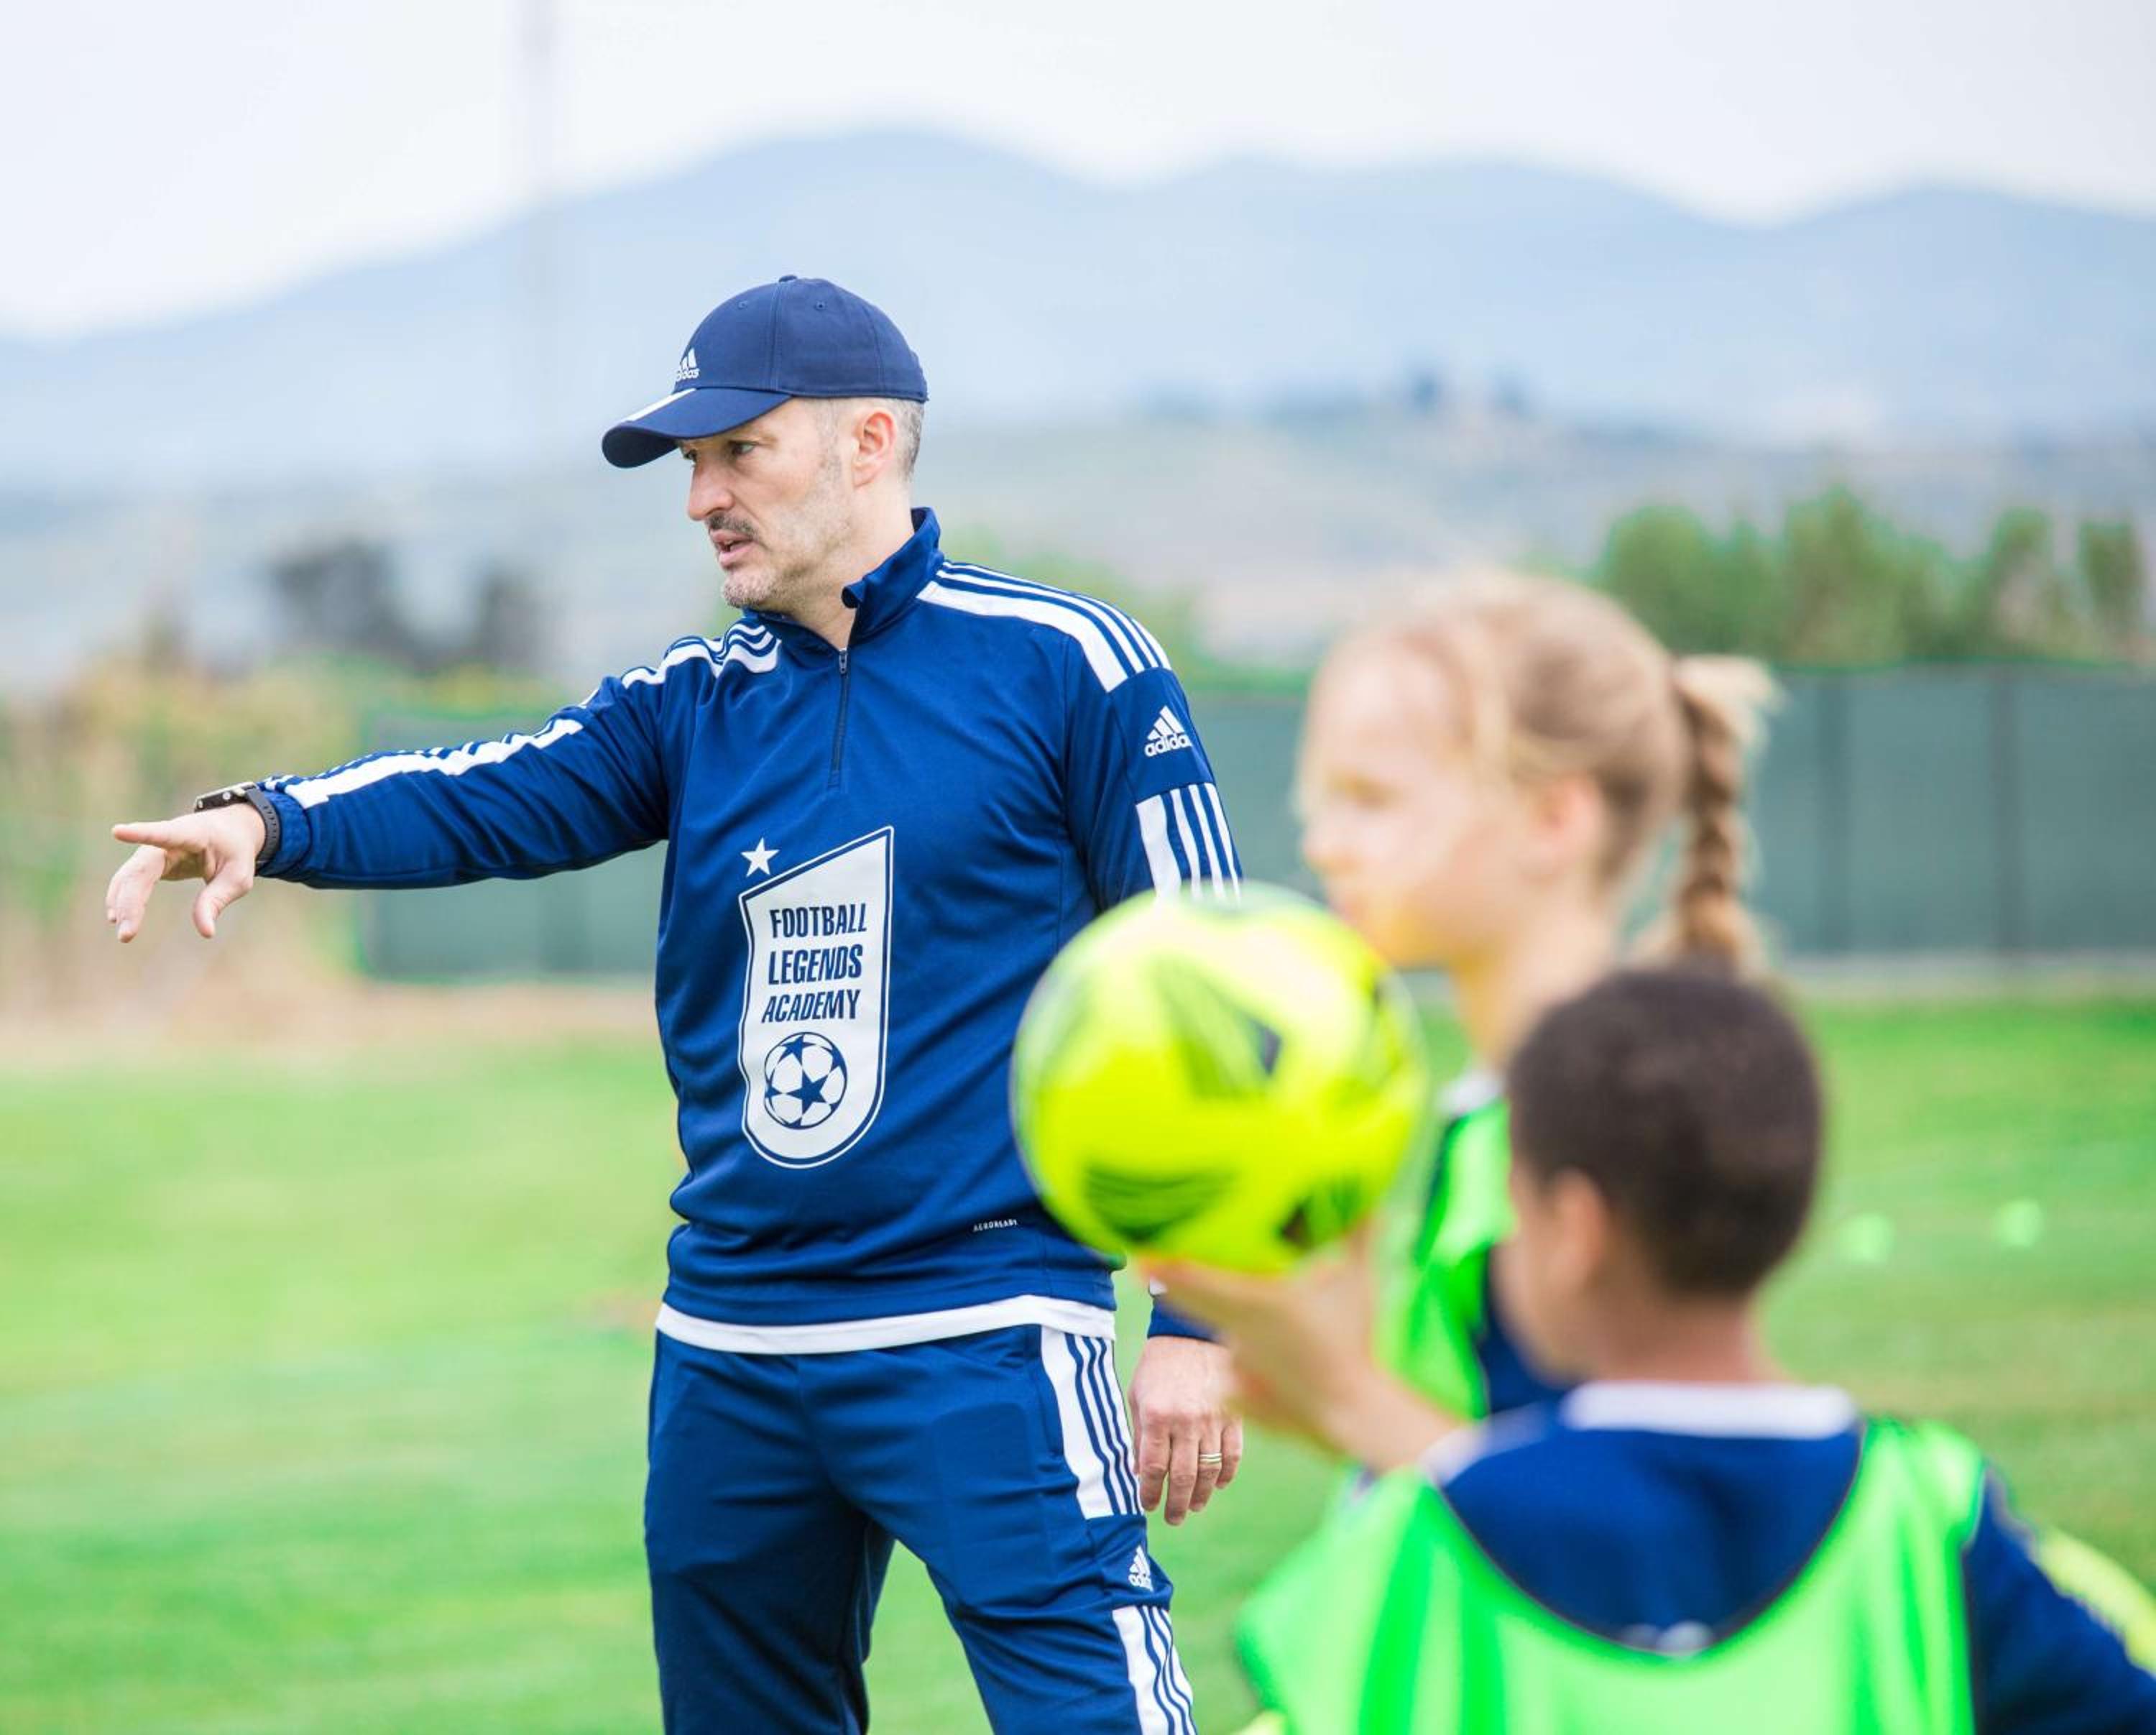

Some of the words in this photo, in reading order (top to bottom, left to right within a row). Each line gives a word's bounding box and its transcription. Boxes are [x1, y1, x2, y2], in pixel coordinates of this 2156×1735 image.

[769, 903, 867, 939] FOOTBALL
[768, 944, 864, 985] LEGENDS
[761, 989, 861, 1023] ACADEMY
